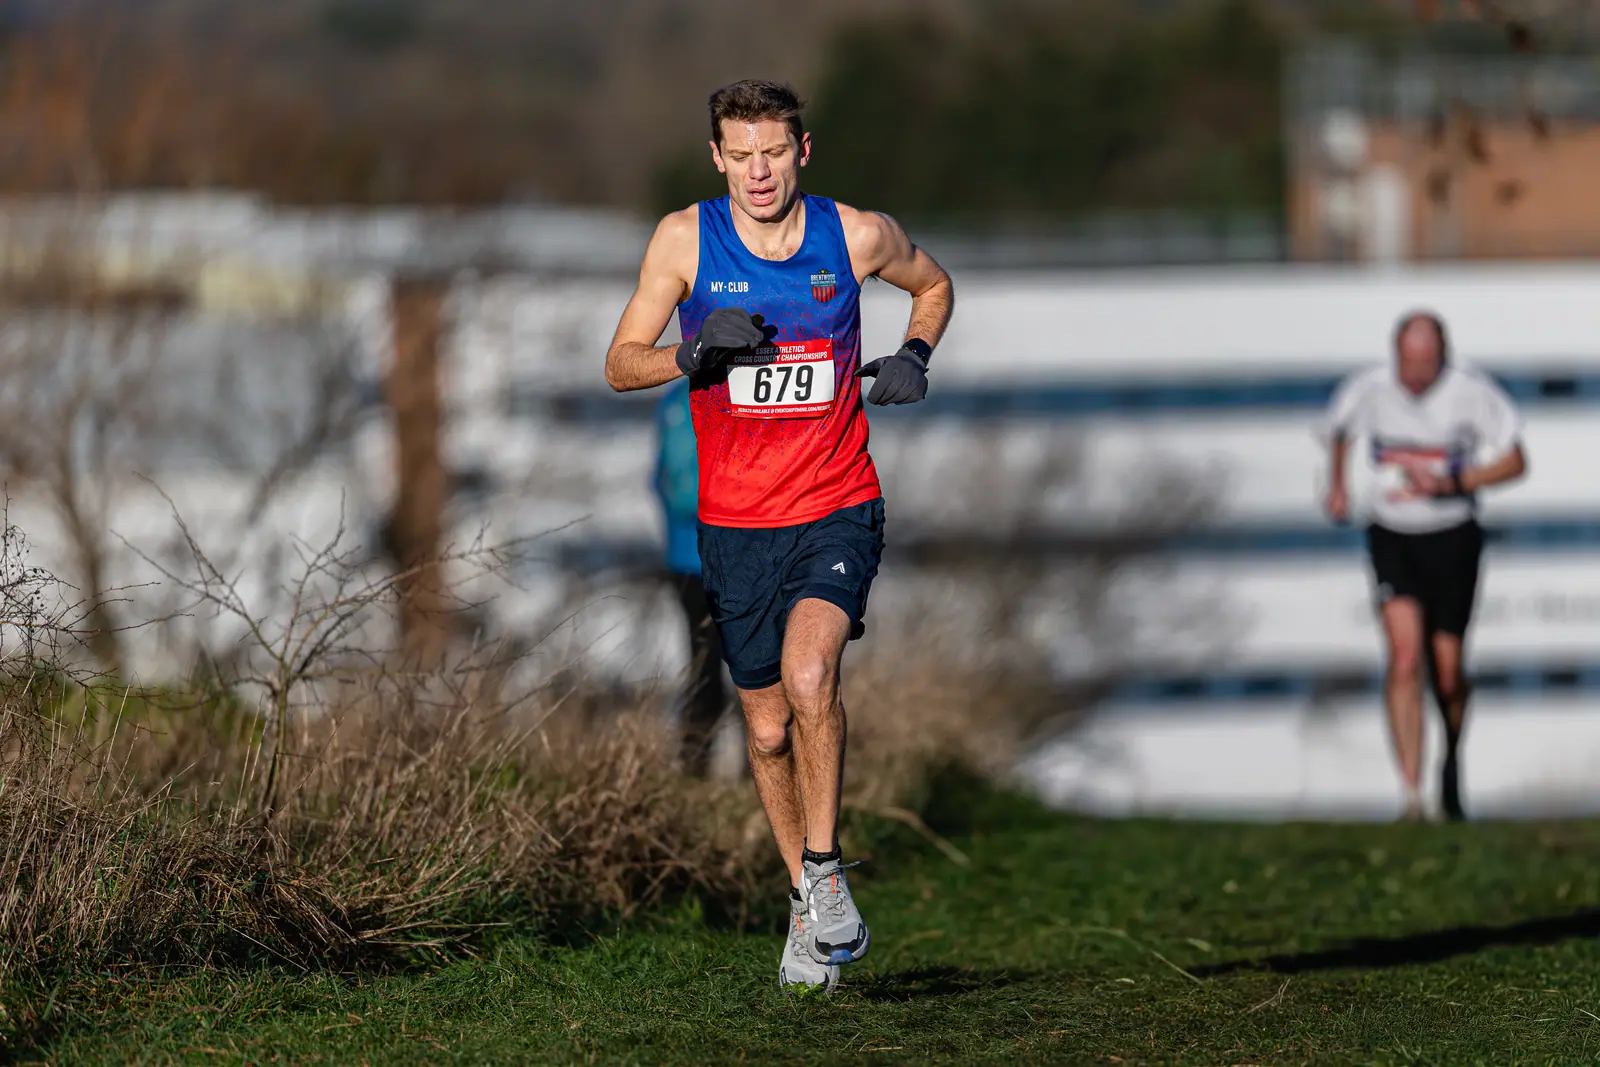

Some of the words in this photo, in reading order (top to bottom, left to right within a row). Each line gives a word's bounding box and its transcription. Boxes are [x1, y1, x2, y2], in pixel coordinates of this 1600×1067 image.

[756, 347, 774, 355] ESSEX
[775, 345, 806, 354] ATHLETICS
[734, 355, 753, 363] CROSS
[754, 354, 781, 362] COUNTRY
[781, 351, 828, 361] CHAMPIONSHIPS
[753, 365, 814, 403] 679
